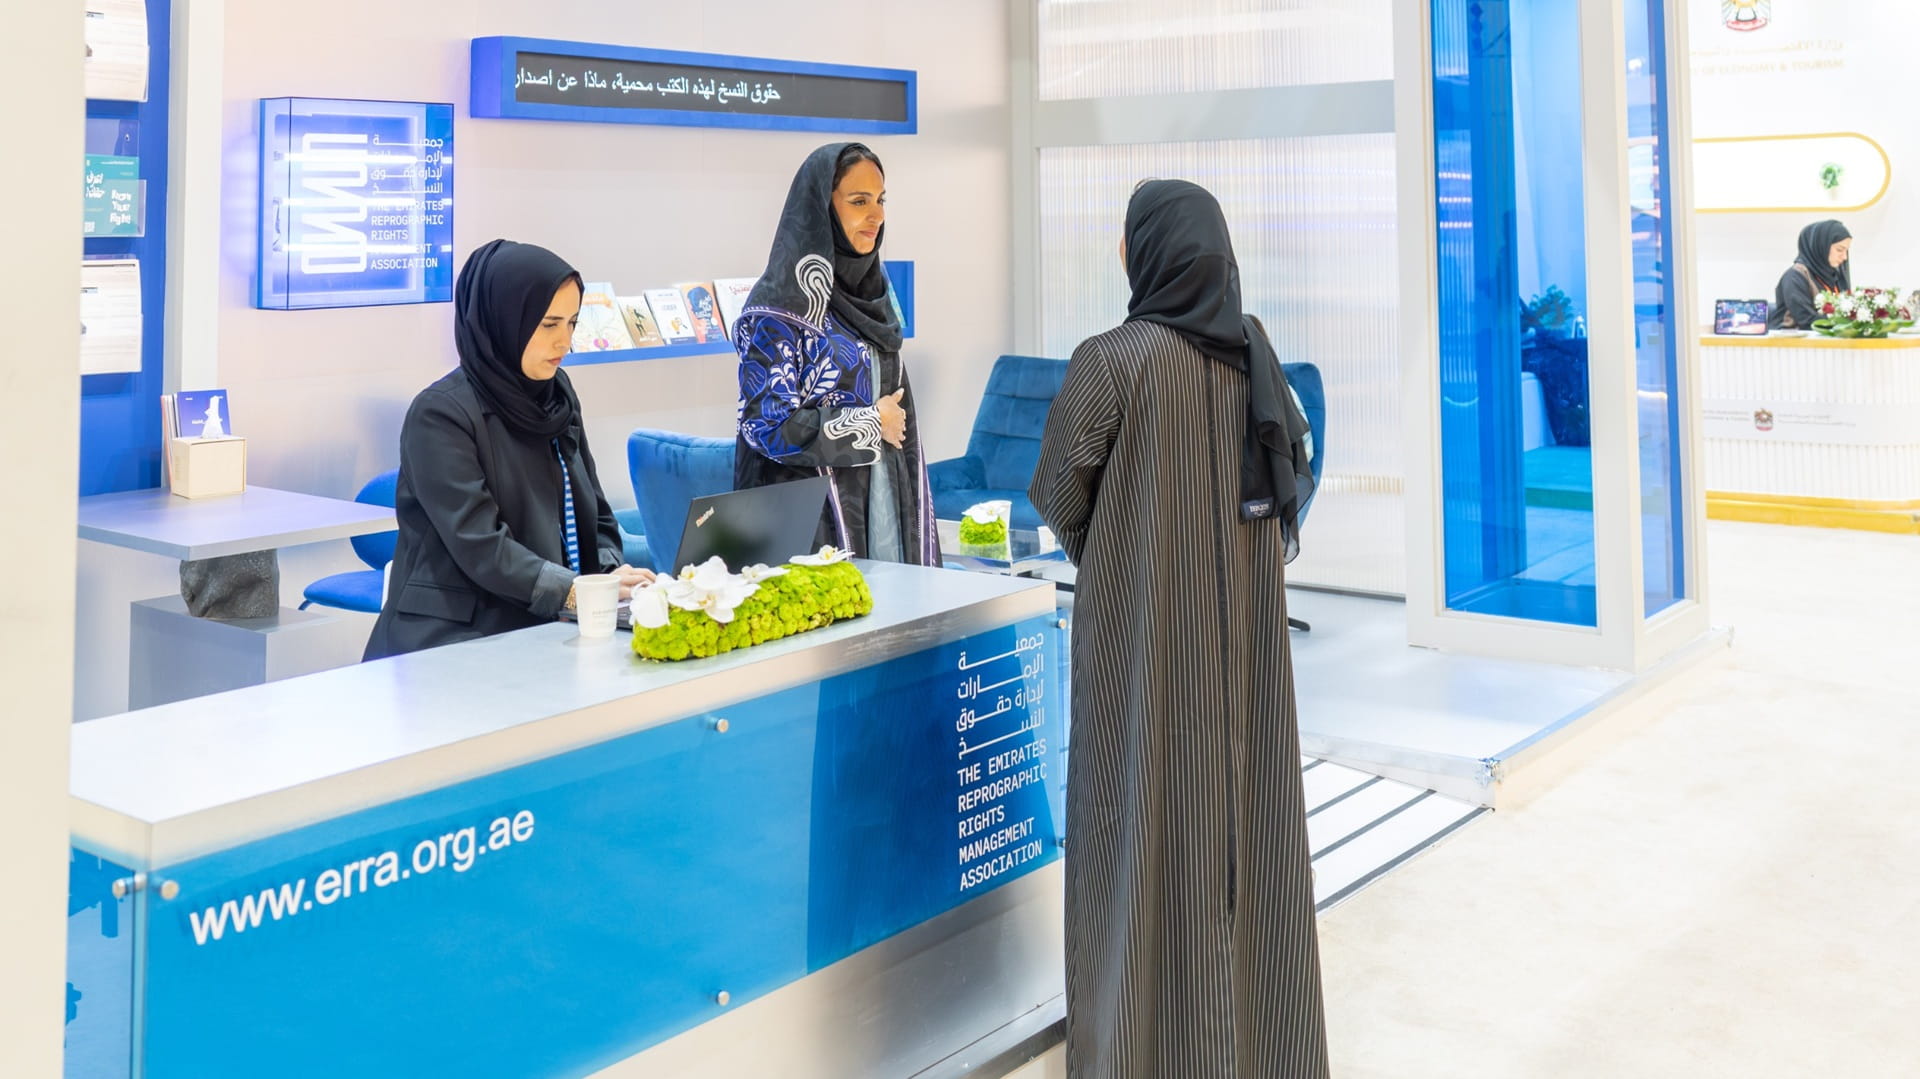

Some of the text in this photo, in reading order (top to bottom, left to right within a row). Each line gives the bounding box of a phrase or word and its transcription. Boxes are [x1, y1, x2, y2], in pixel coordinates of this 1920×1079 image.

[557, 72, 578, 90] عن
[584, 69, 606, 89] ماذا
[656, 75, 689, 95] الكتب
[690, 78, 716, 97] لهذه
[717, 81, 748, 103] النسخ
[751, 84, 781, 104] حقوق
[371, 215, 444, 226] REPROGRAPHIC
[371, 229, 409, 241] RIGHTS
[370, 257, 438, 270] ASSOCIATION
[958, 632, 1044, 671] جمعية
[957, 653, 1044, 700] الإمارات
[956, 679, 1044, 733] لإدارة حقوق
[958, 708, 1045, 760] النسخ
[957, 738, 1047, 787] THE EMIRATES
[957, 762, 1048, 813] REPROGRAPHIC
[958, 805, 1005, 839] RIGHTS
[959, 816, 1035, 865] MANAGEMENT
[189, 809, 535, 946] www.erra.org.ae
[960, 838, 1043, 892] ASSOCIATION
